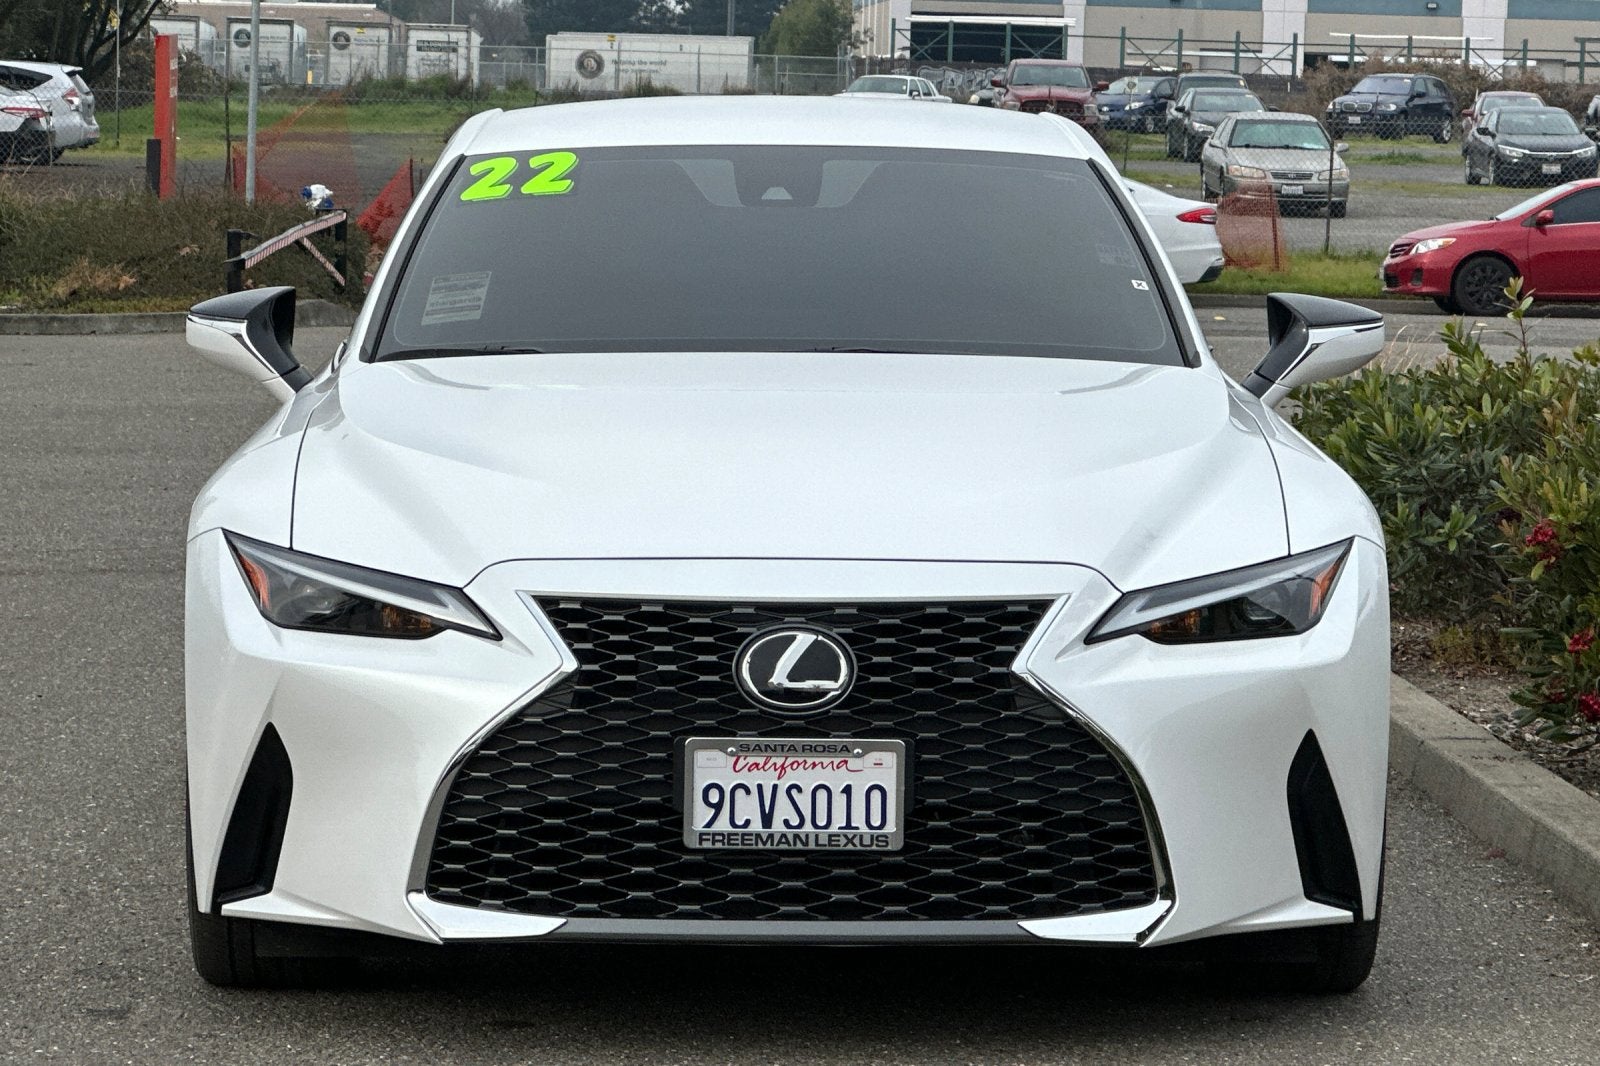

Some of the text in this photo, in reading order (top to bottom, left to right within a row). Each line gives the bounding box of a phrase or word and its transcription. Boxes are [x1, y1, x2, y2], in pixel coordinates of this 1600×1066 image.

[460, 151, 579, 201] 22
[739, 743, 851, 754] SANTA ROSA
[732, 755, 864, 781] California
[701, 782, 888, 831] 9CVS010
[697, 832, 890, 848] FREEMAN LEXUS
